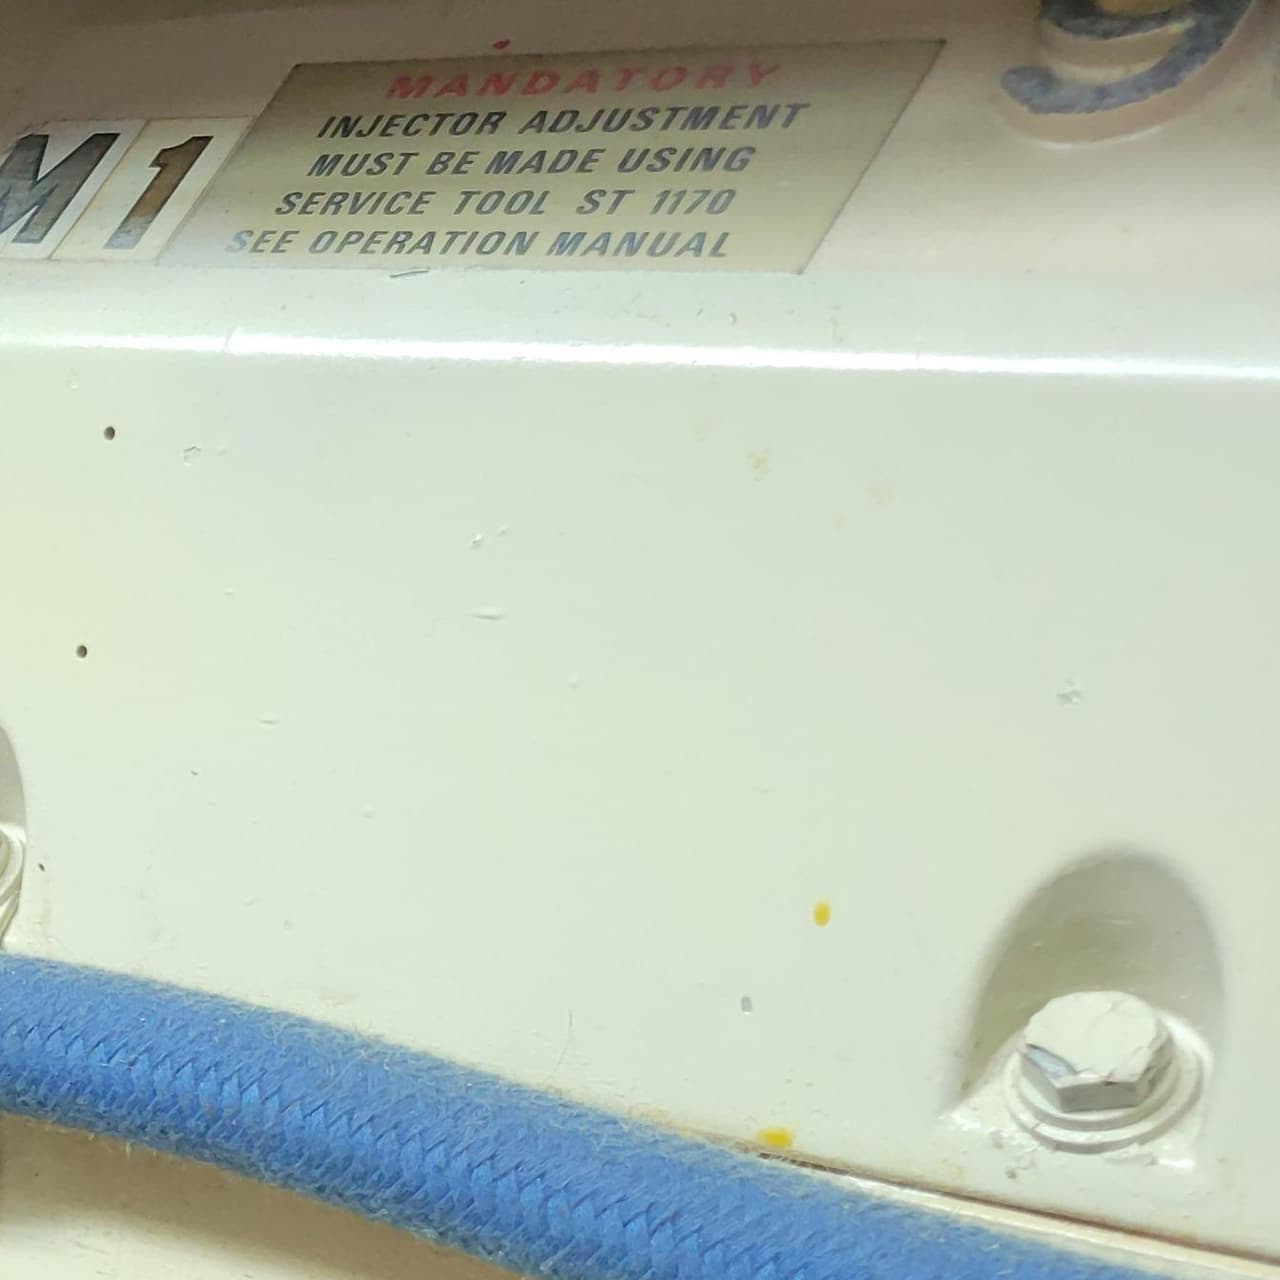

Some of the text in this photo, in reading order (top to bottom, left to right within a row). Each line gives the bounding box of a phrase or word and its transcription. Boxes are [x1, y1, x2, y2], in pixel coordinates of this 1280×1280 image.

[386, 62, 781, 99] MANDATORY
[315, 103, 811, 138] INJECTOR ADJUSTMENT
[306, 146, 756, 176] MUST BE MADE USING
[275, 188, 737, 215] SERVICE TOOL ST 1170
[224, 229, 730, 257] SEE OPERATION MANUAL
